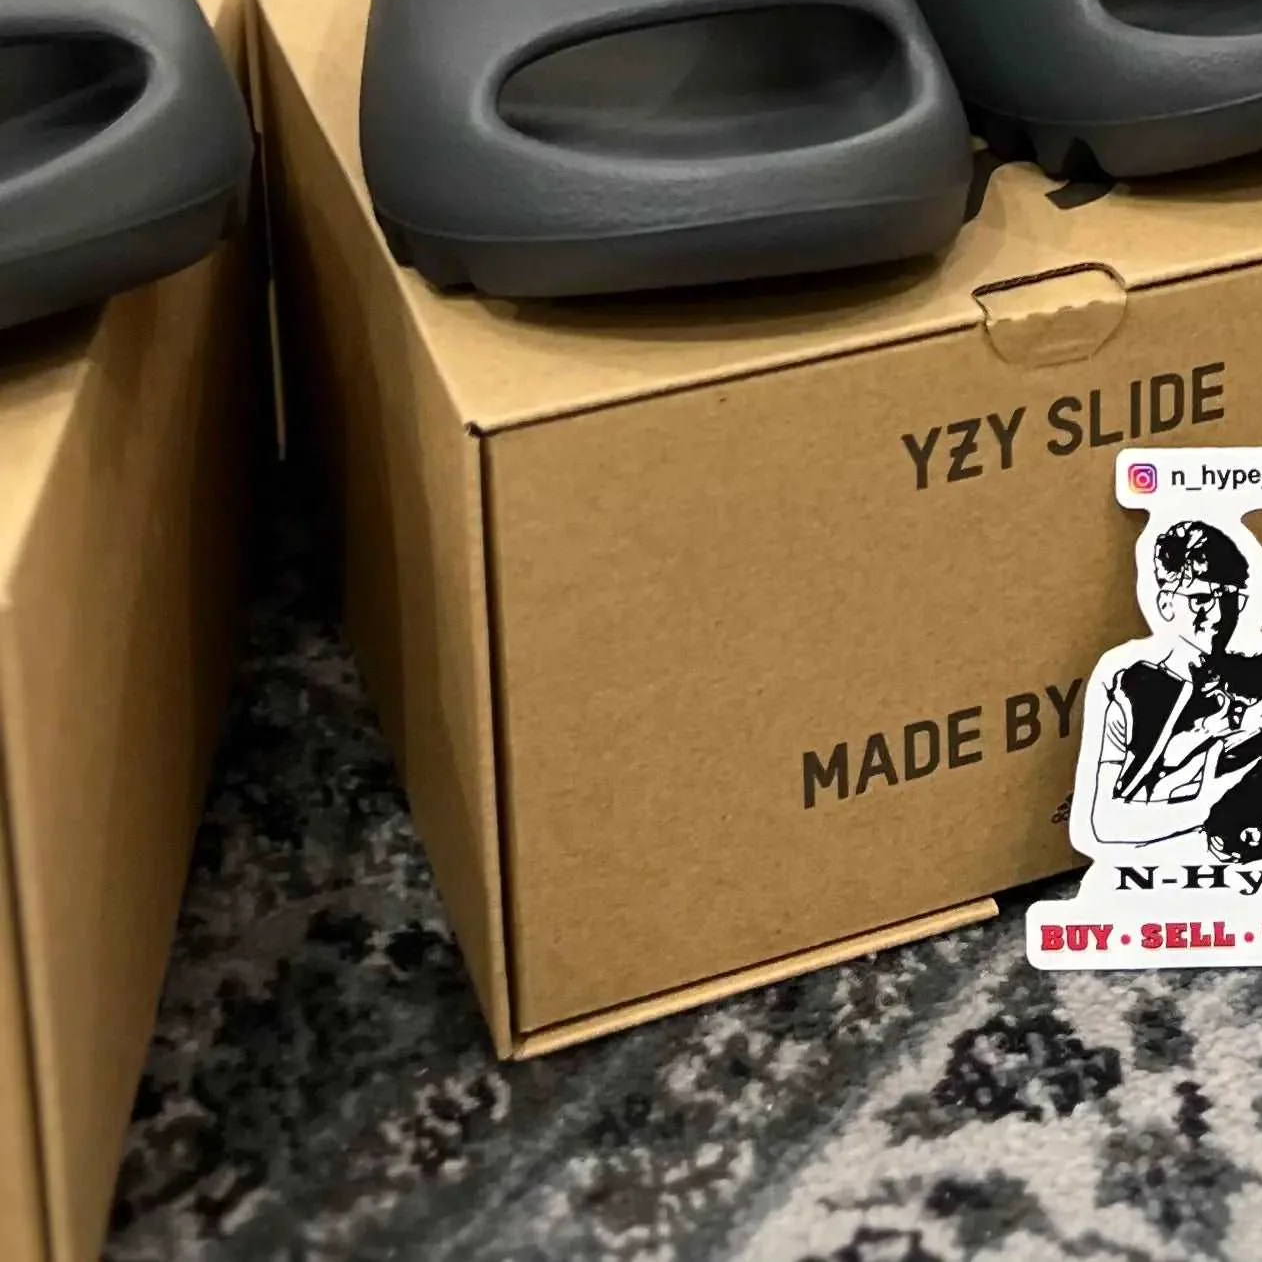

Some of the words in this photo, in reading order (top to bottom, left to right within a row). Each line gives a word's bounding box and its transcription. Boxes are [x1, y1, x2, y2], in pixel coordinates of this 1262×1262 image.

[901, 406, 1027, 491] YZY
[1047, 361, 1225, 457] SLIDE
[803, 705, 983, 810] MADE
[1005, 678, 1083, 753] BY
[1040, 924, 1114, 951] BUY
[1141, 921, 1236, 949] SELL
